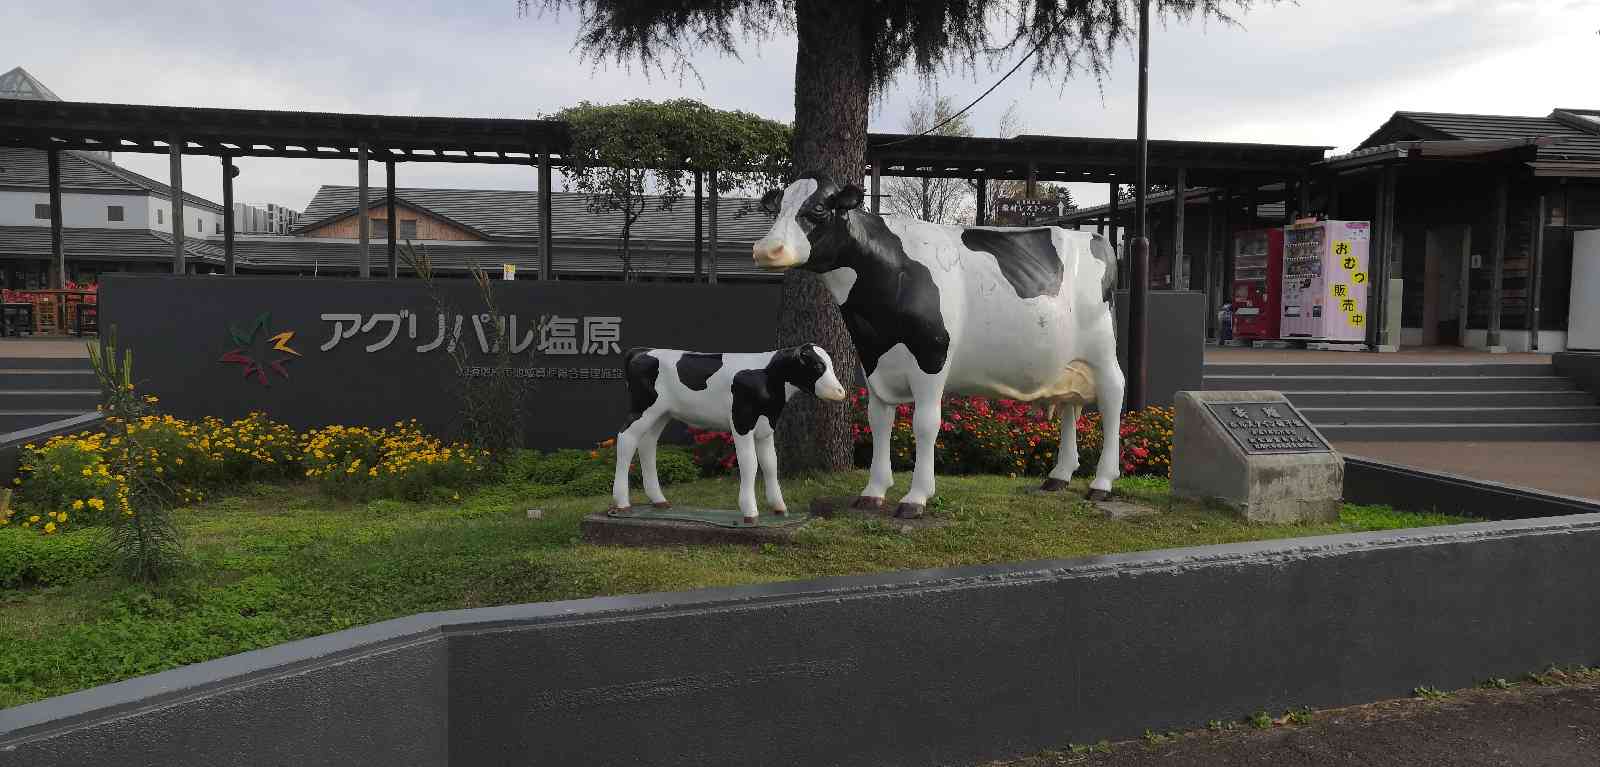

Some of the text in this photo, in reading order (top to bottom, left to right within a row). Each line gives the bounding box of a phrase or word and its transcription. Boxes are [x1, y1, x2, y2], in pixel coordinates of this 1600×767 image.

[1335, 242, 1365, 284] おむつ
[1333, 284, 1363, 328] 販売中
[320, 309, 622, 355] アグリパル塩原
